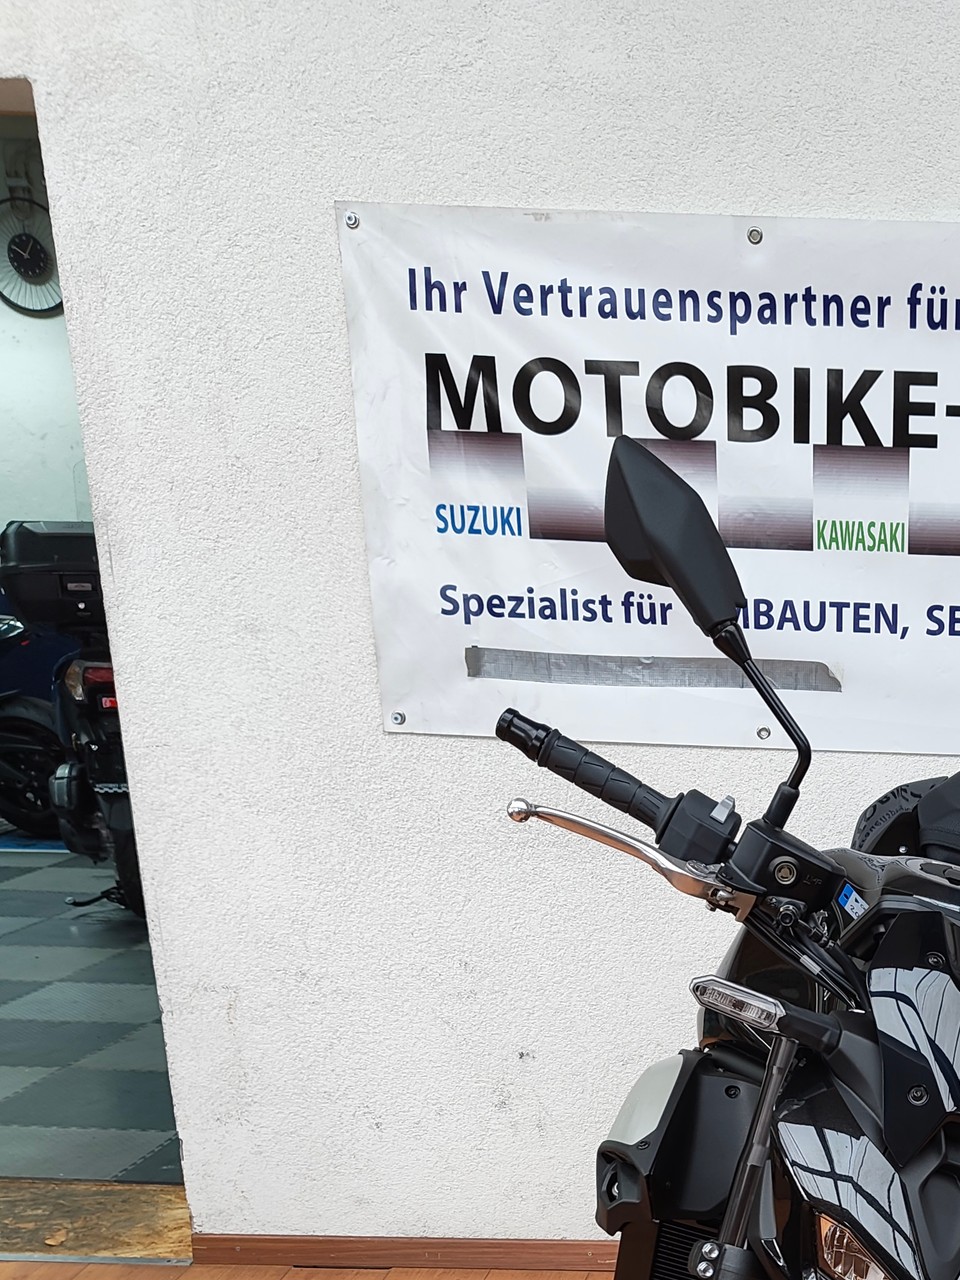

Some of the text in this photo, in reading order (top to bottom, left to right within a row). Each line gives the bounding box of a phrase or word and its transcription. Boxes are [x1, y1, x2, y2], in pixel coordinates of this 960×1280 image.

[408, 266, 468, 314] Ihr
[481, 270, 892, 336] Vertrauenspartner
[435, 503, 523, 537] SUZUKI
[816, 519, 907, 554] KAWASAKI
[439, 584, 613, 625] Spezialist
[620, 592, 673, 627] für
[737, 598, 910, 640] BAUTEN,
